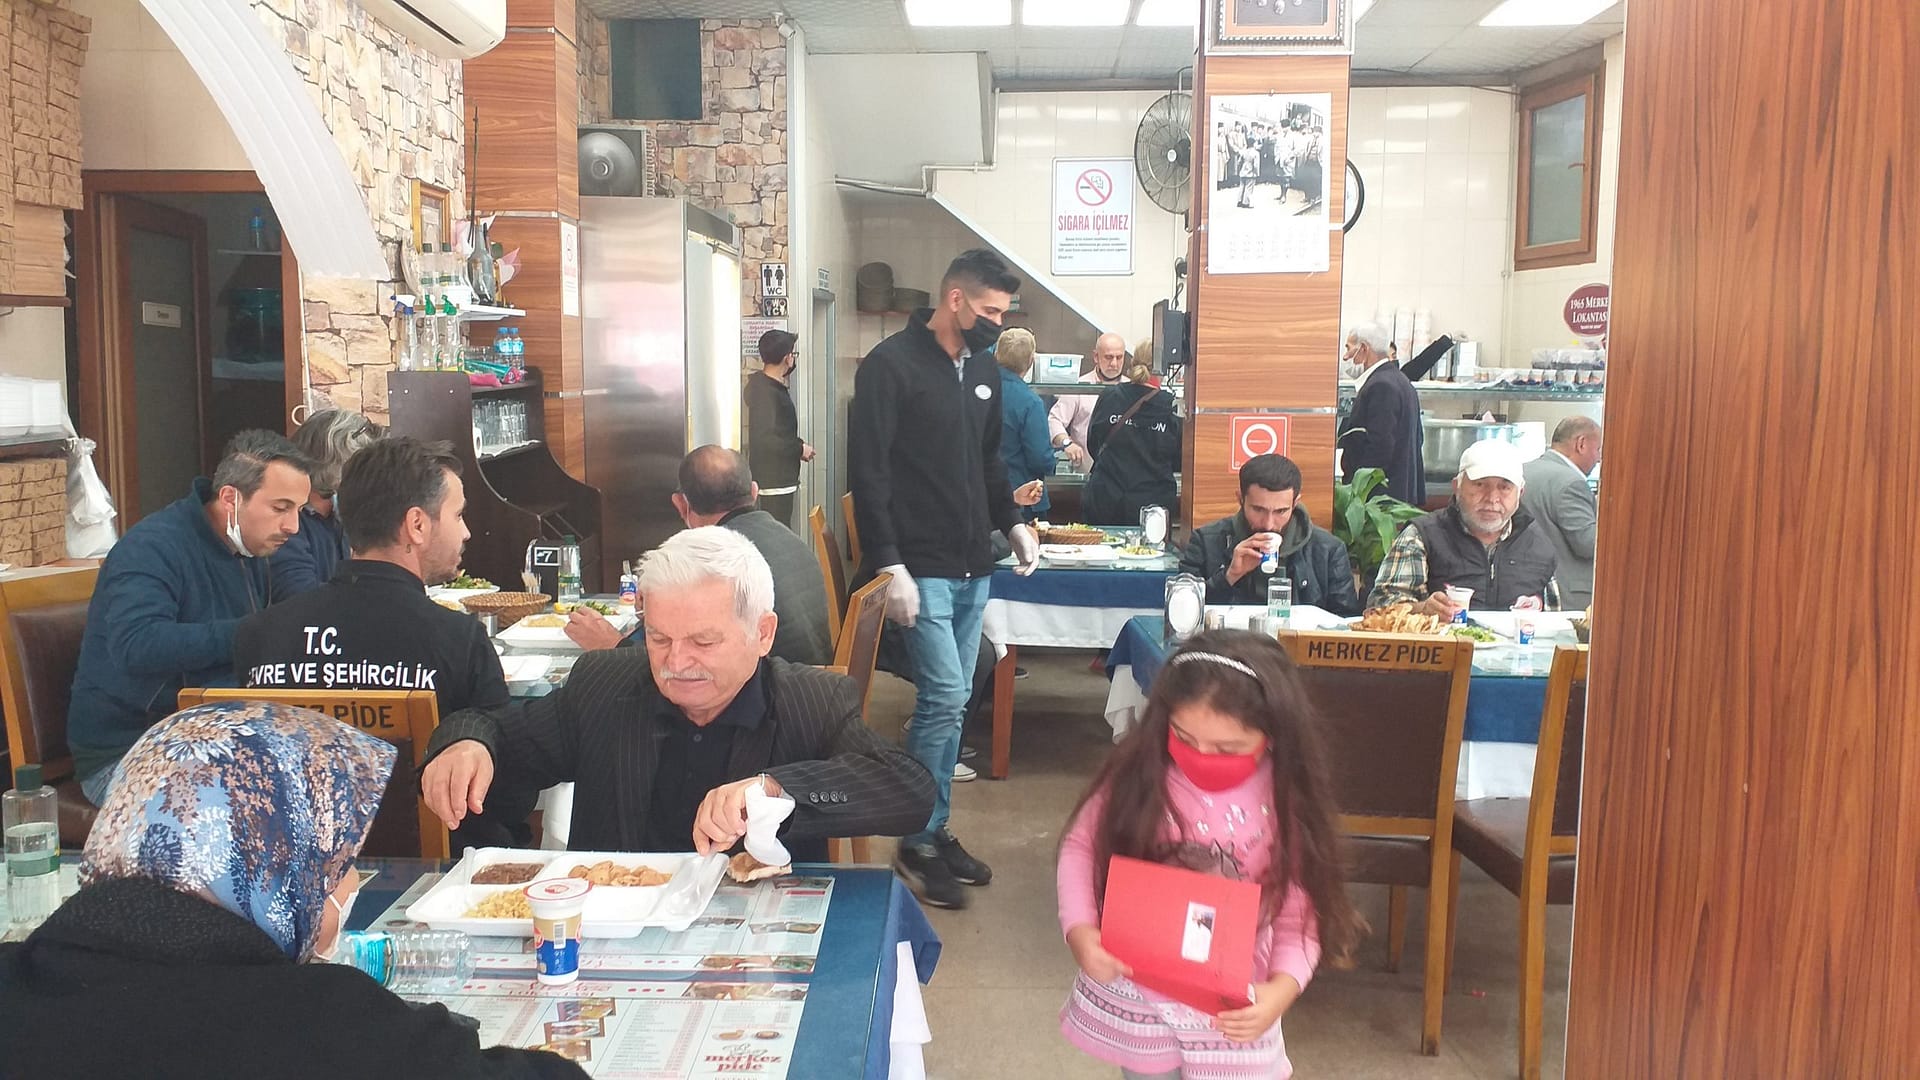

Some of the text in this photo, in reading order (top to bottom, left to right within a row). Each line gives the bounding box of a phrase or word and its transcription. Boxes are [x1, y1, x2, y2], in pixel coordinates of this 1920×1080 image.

[1092, 210, 1129, 235] İÇİLMEZ
[767, 287, 783, 295] WC
[1585, 296, 1608, 308] MERKE
[1572, 311, 1607, 323] LOKANTAS
[303, 626, 342, 655] T.C.
[1308, 640, 1444, 665] MERKEZ PİDE
[246, 659, 437, 690] EVRE VE ŞEHİRCİLİK
[333, 701, 394, 729] PİDE
[704, 1054, 783, 1064] merkez
[717, 1061, 763, 1072] pide
